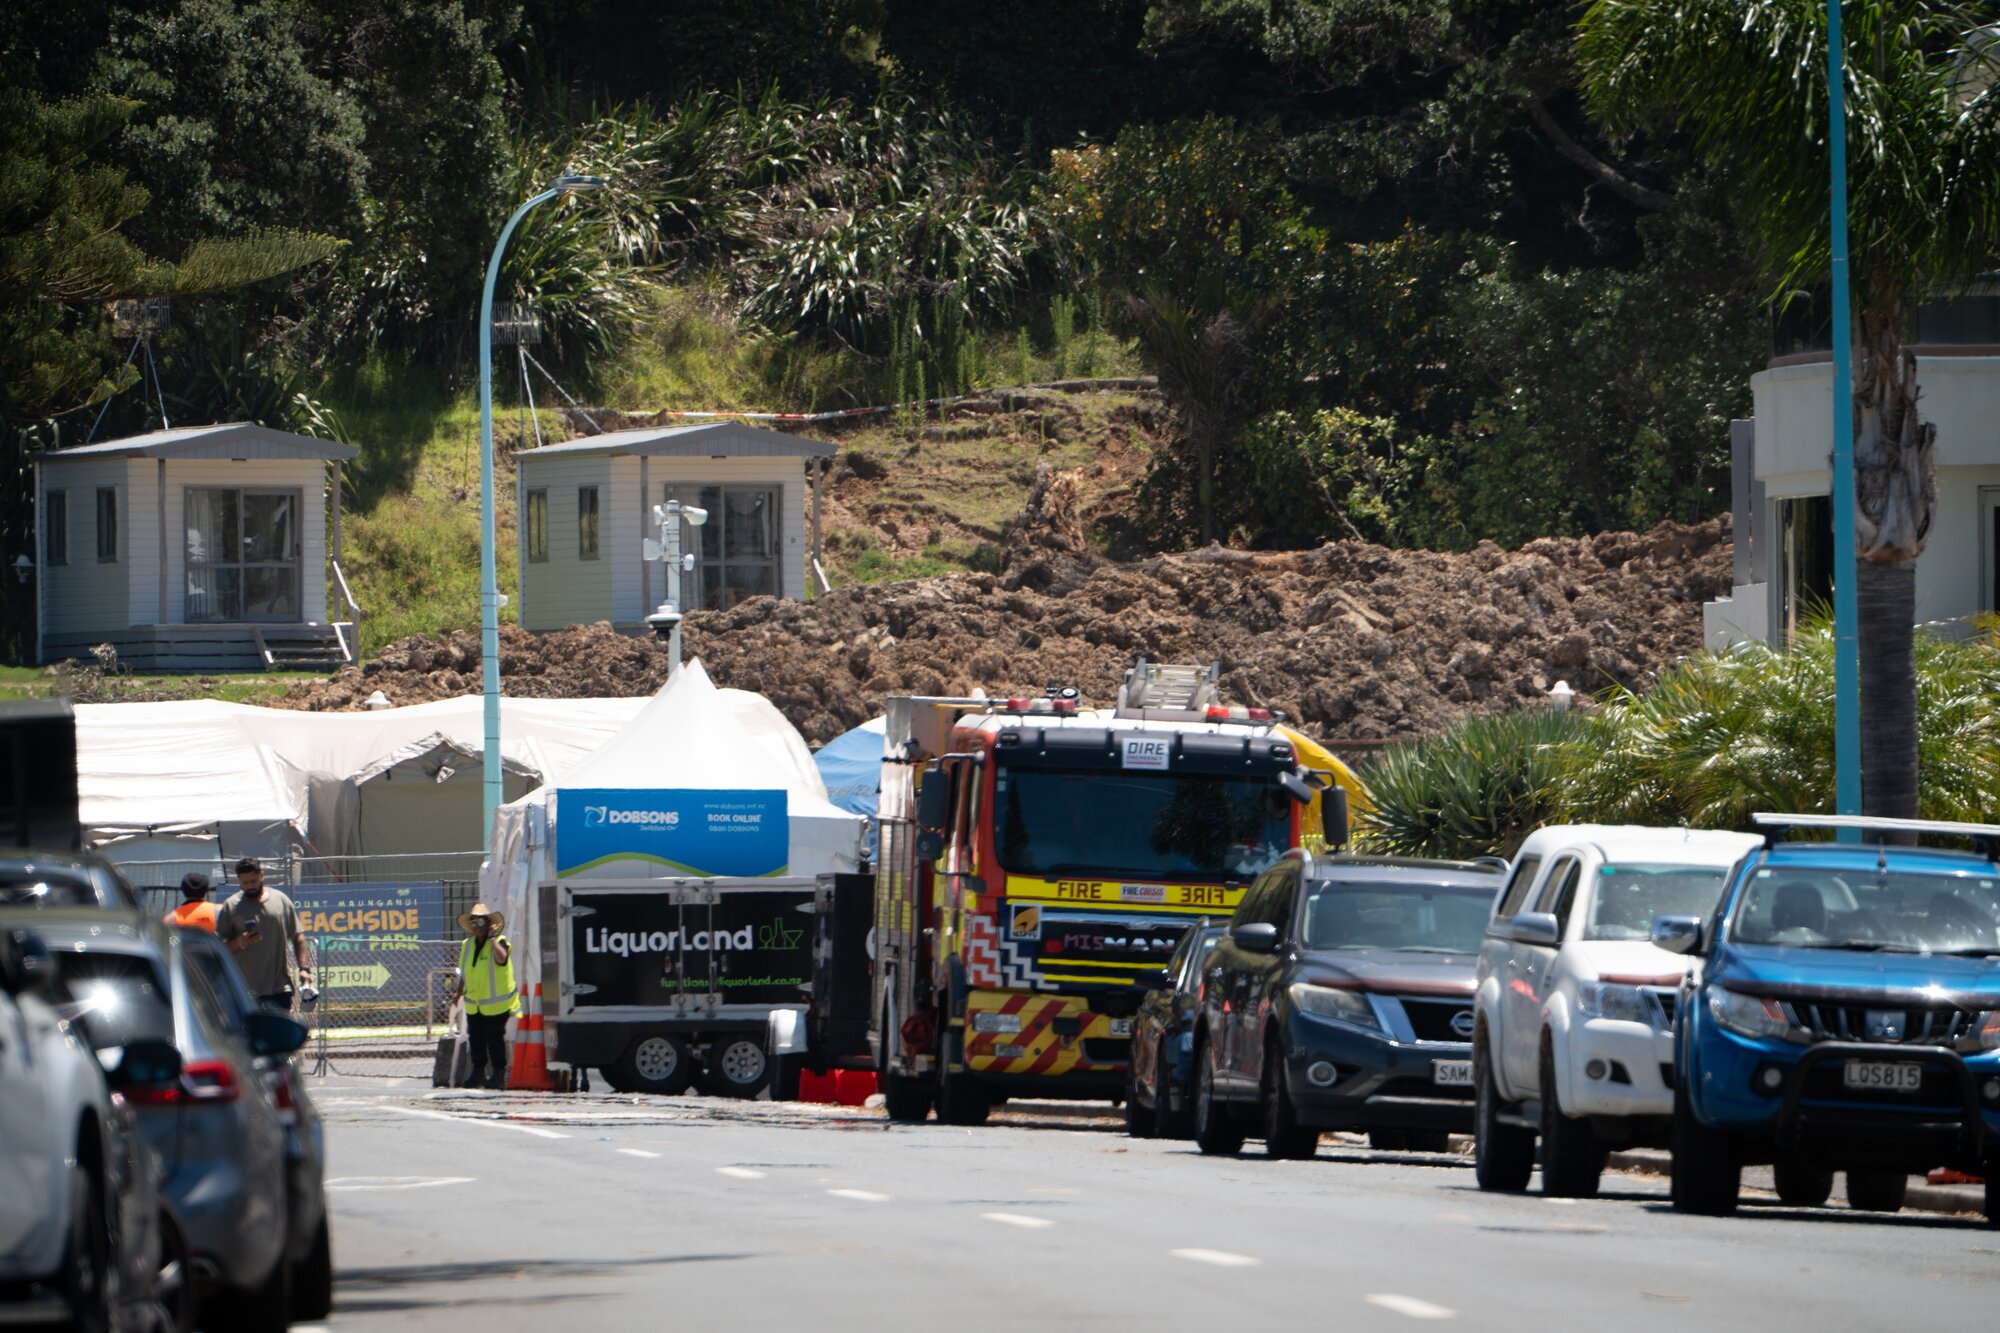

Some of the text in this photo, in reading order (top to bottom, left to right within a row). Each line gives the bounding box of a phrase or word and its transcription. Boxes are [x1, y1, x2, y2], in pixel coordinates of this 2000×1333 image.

[1127, 742, 1166, 755] DIRE
[609, 810, 680, 825] DOBSONS
[707, 814, 761, 823] BOOK ONLINE
[1057, 882, 1102, 899] FIRE
[293, 899, 418, 909] OUNT MAUNGANUI
[299, 908, 420, 933] EACHSIDE
[316, 933, 421, 951] IDAY PARK
[585, 925, 753, 957] LiquorLand
[1439, 1064, 1472, 1081] SAM
